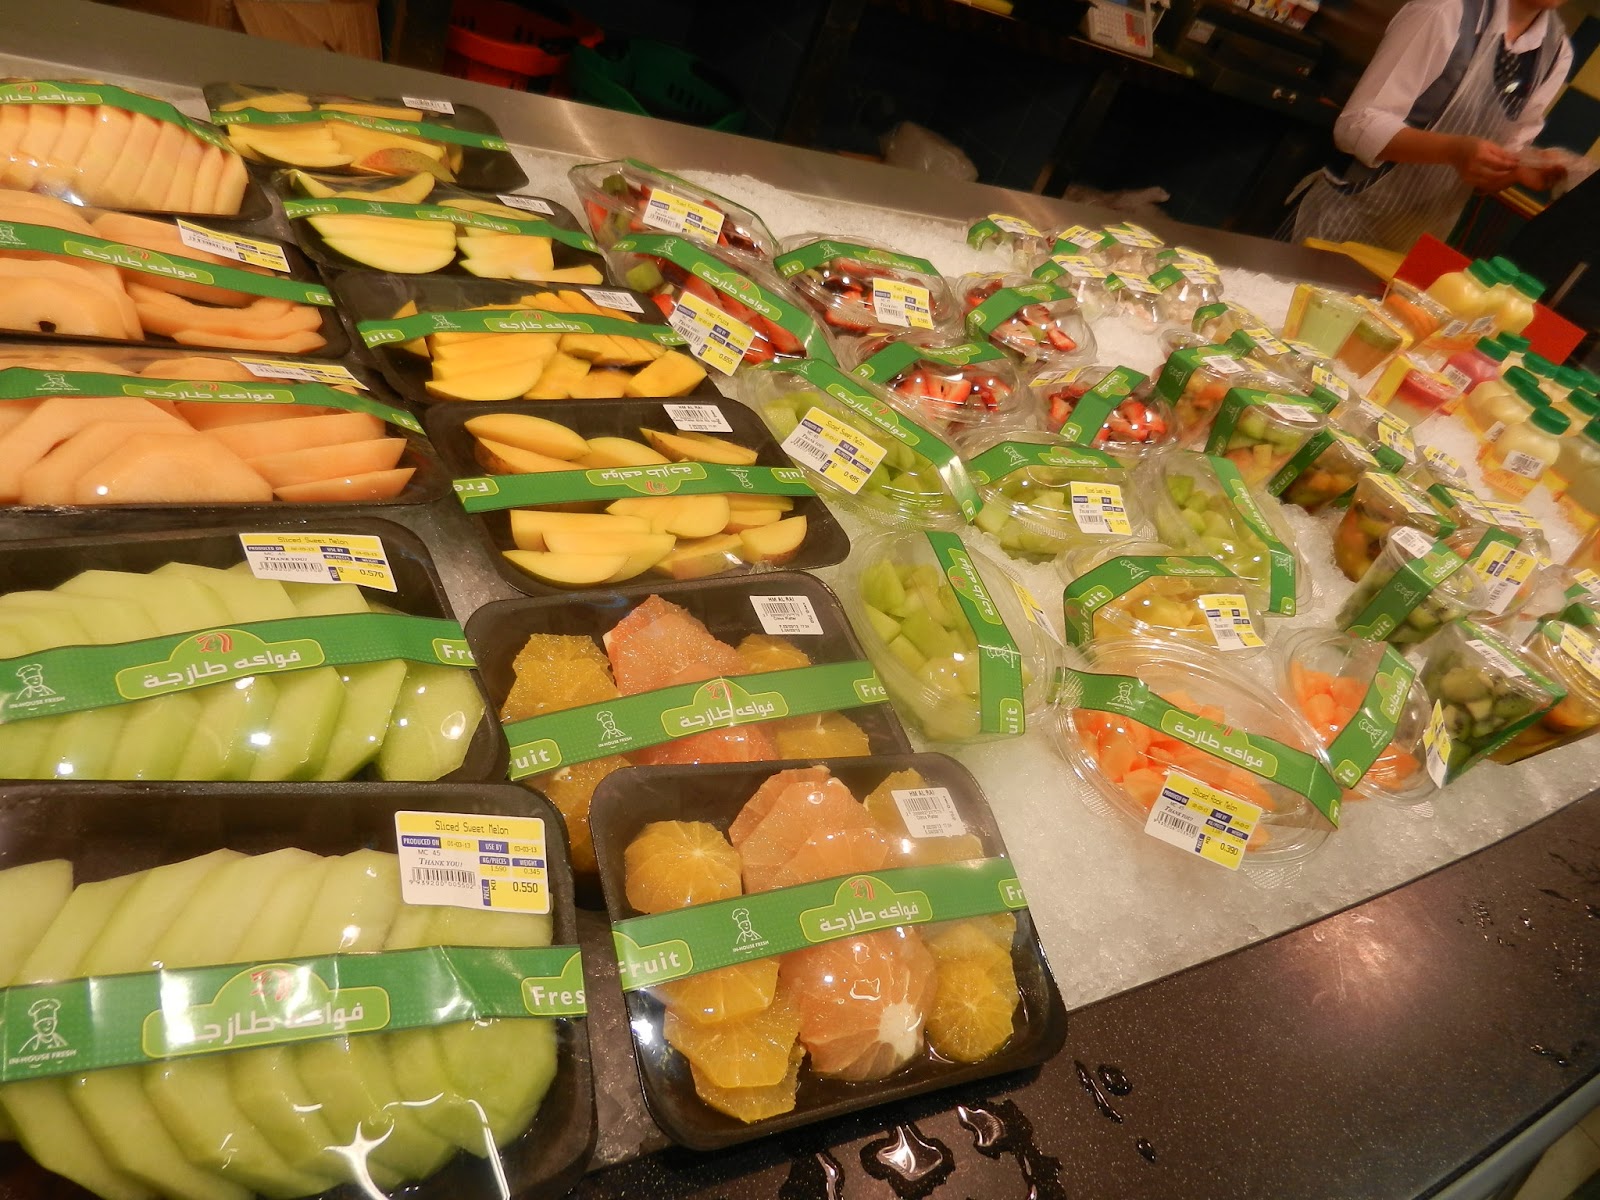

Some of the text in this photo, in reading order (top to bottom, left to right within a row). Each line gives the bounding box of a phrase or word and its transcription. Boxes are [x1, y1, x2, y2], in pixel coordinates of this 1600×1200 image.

[0, 94, 33, 102] طاز
[286, 206, 331, 216] Fruit
[82, 248, 198, 280] فواكه طازجة
[702, 270, 770, 314] فواكه طازجة
[500, 320, 542, 330] طازجة
[144, 390, 276, 402] فواكه طازجة
[837, 391, 907, 439] فواكه طازجة
[360, 569, 384, 578] 0.570
[1080, 590, 1106, 619] Fruit
[144, 650, 302, 688] فواكه طازجة
[862, 684, 886, 697] Fre
[679, 700, 775, 728] فواكه طازجة
[1174, 720, 1263, 769] فواكه طازجة
[435, 820, 509, 835] Sliced Sweet Melon
[419, 857, 445, 866] THANK
[512, 882, 538, 893] 0.550
[1006, 886, 1025, 901] Fr
[818, 900, 920, 932] فواكه طازجة
[732, 940, 770, 953] IN-HOUSE FRESH
[532, 986, 586, 1005] Fres
[9, 1049, 78, 1064] IN-HOUSE FRESH
